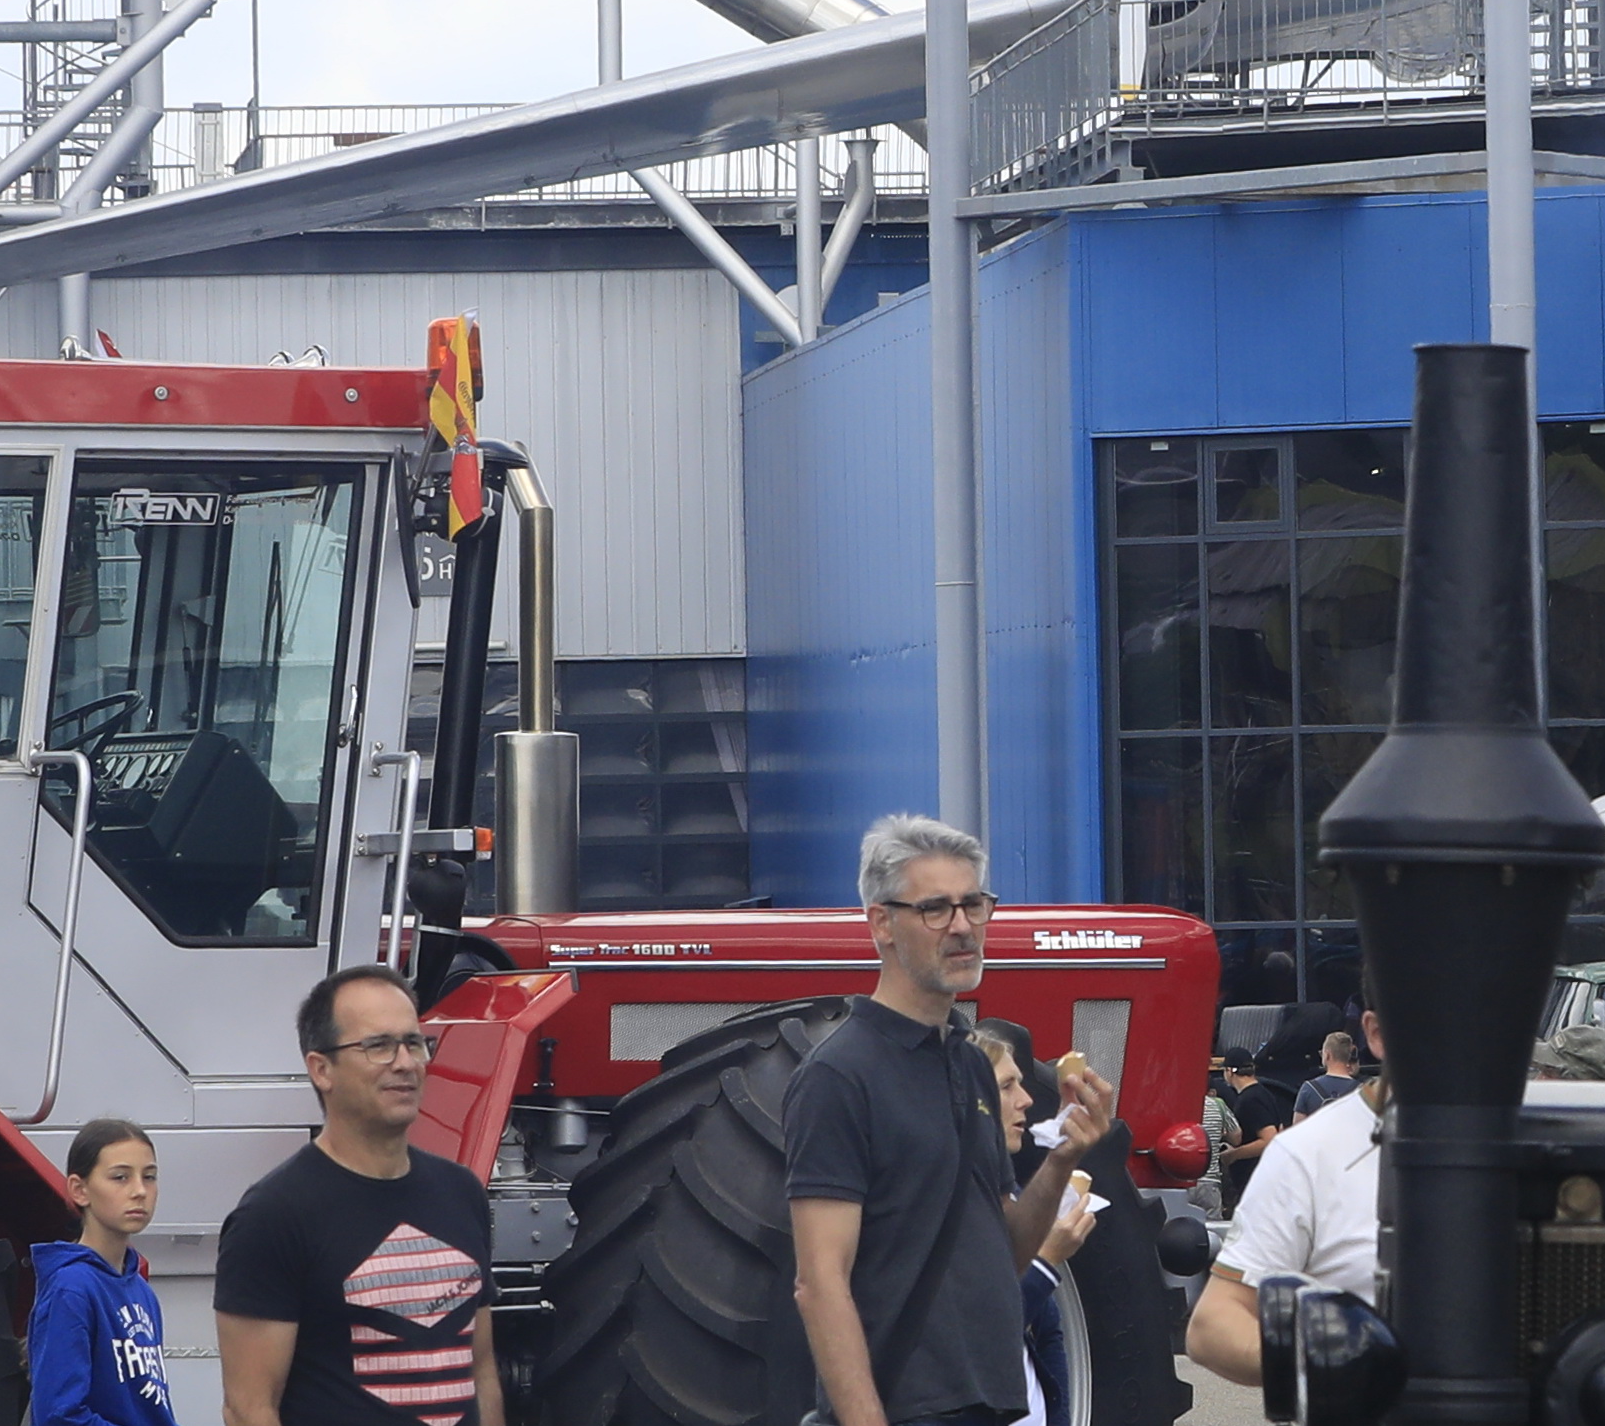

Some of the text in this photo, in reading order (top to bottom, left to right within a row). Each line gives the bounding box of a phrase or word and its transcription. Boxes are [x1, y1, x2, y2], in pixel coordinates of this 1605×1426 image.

[115, 488, 214, 521] RENN
[550, 944, 595, 958] Super
[598, 943, 630, 955] Trac
[632, 944, 676, 955] 1600
[1033, 929, 1144, 951] Schlüter
